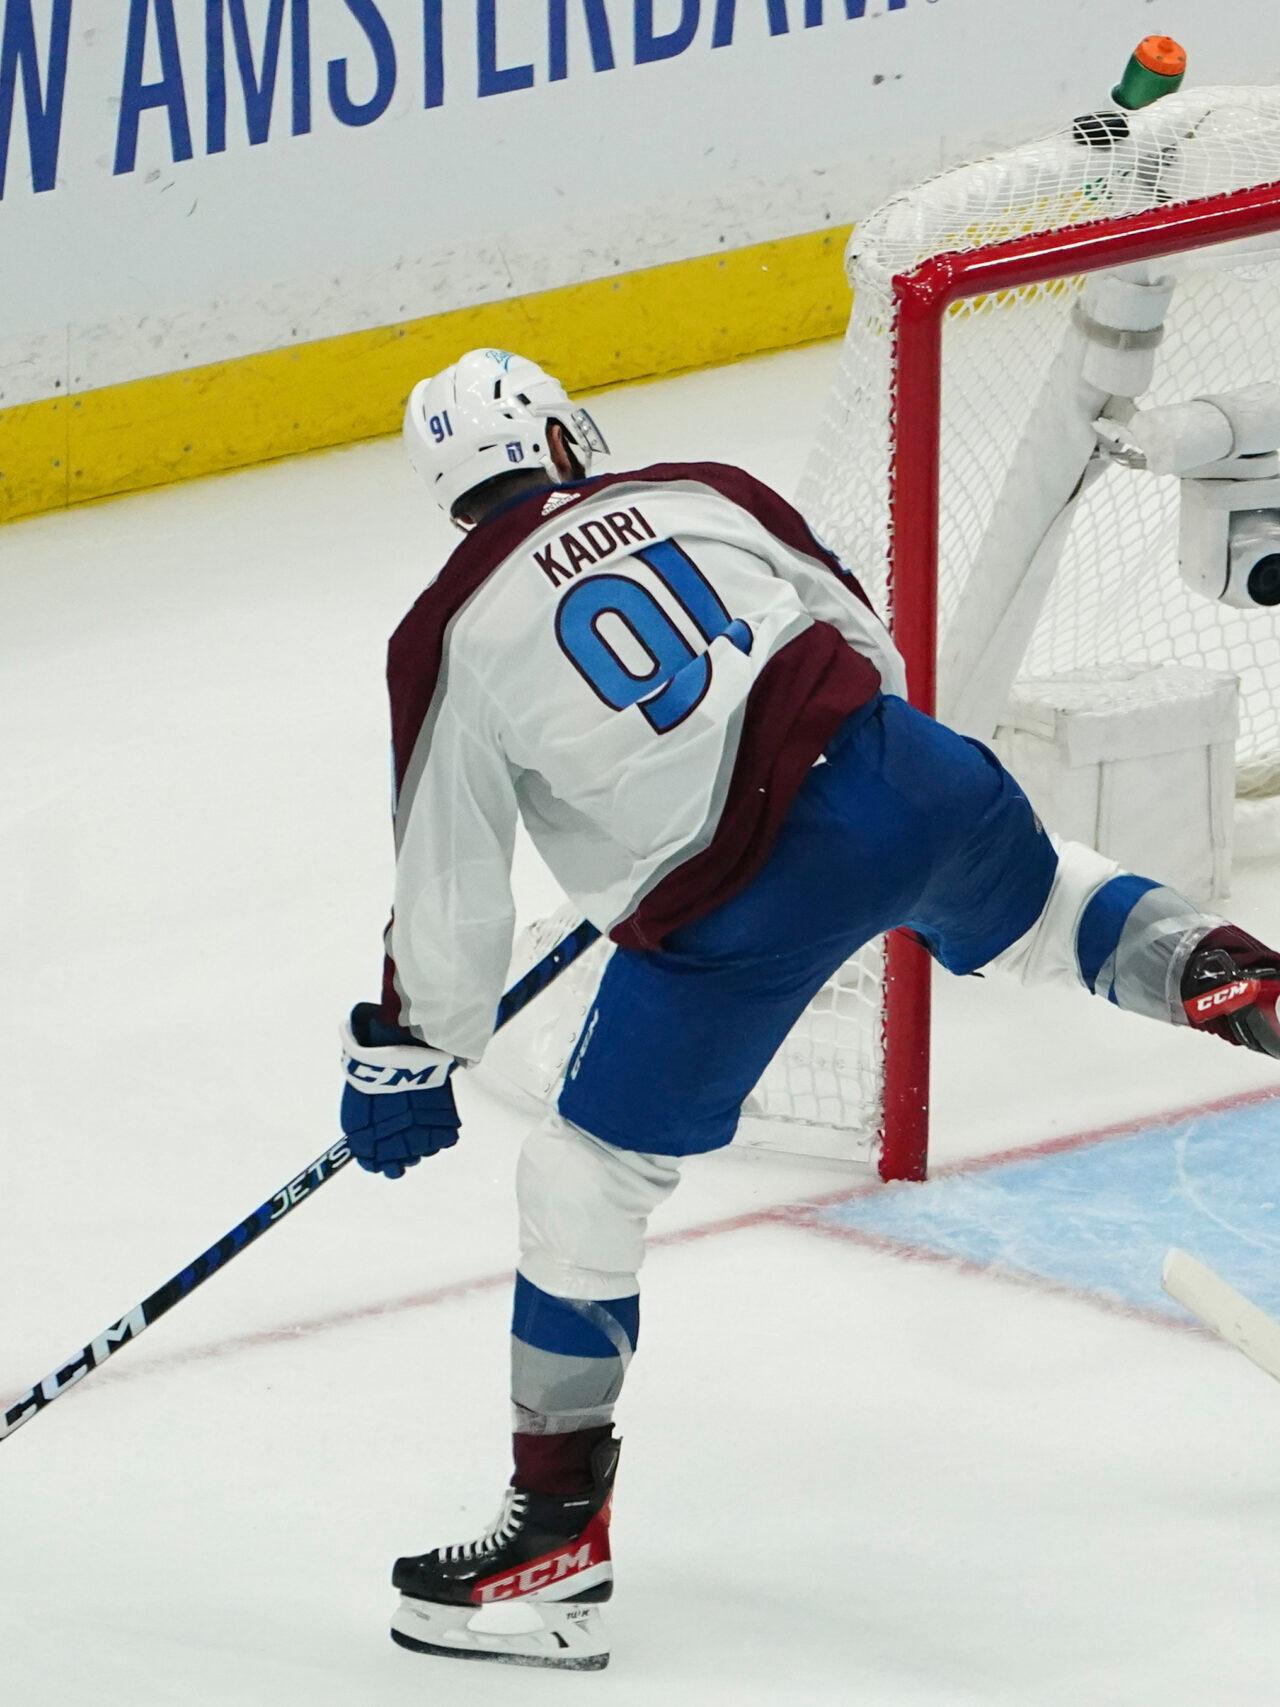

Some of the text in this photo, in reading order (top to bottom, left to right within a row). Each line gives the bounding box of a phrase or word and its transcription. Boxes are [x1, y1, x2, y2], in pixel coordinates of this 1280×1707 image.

[429, 410, 453, 443] 91
[532, 506, 657, 588] KADRI
[554, 536, 754, 736] 91
[1196, 981, 1249, 1012] CCM
[341, 1049, 438, 1086] CM
[269, 1135, 353, 1220] JETS
[0, 1303, 149, 1440] CCM
[477, 1542, 593, 1602] CCM
